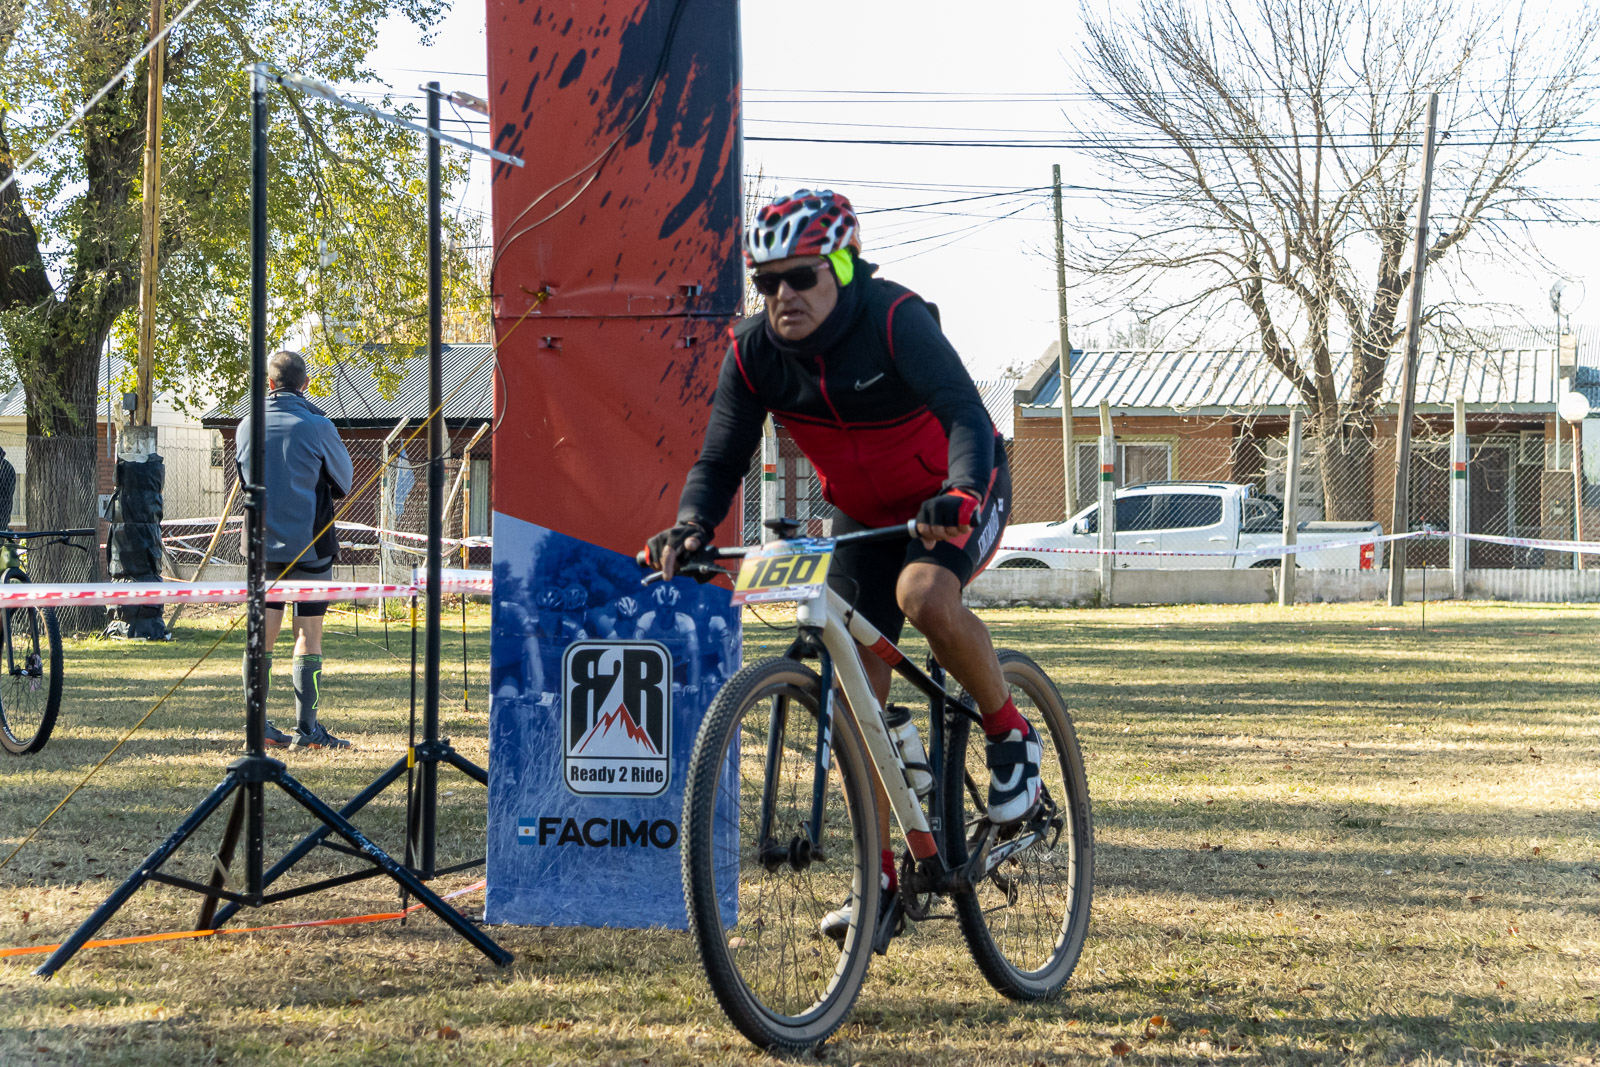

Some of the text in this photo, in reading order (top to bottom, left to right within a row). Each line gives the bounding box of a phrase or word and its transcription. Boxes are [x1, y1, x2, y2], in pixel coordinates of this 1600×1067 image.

[747, 555, 823, 589] 160
[571, 765, 664, 784] Ready 2 Ride
[538, 817, 679, 849] FACIMO
